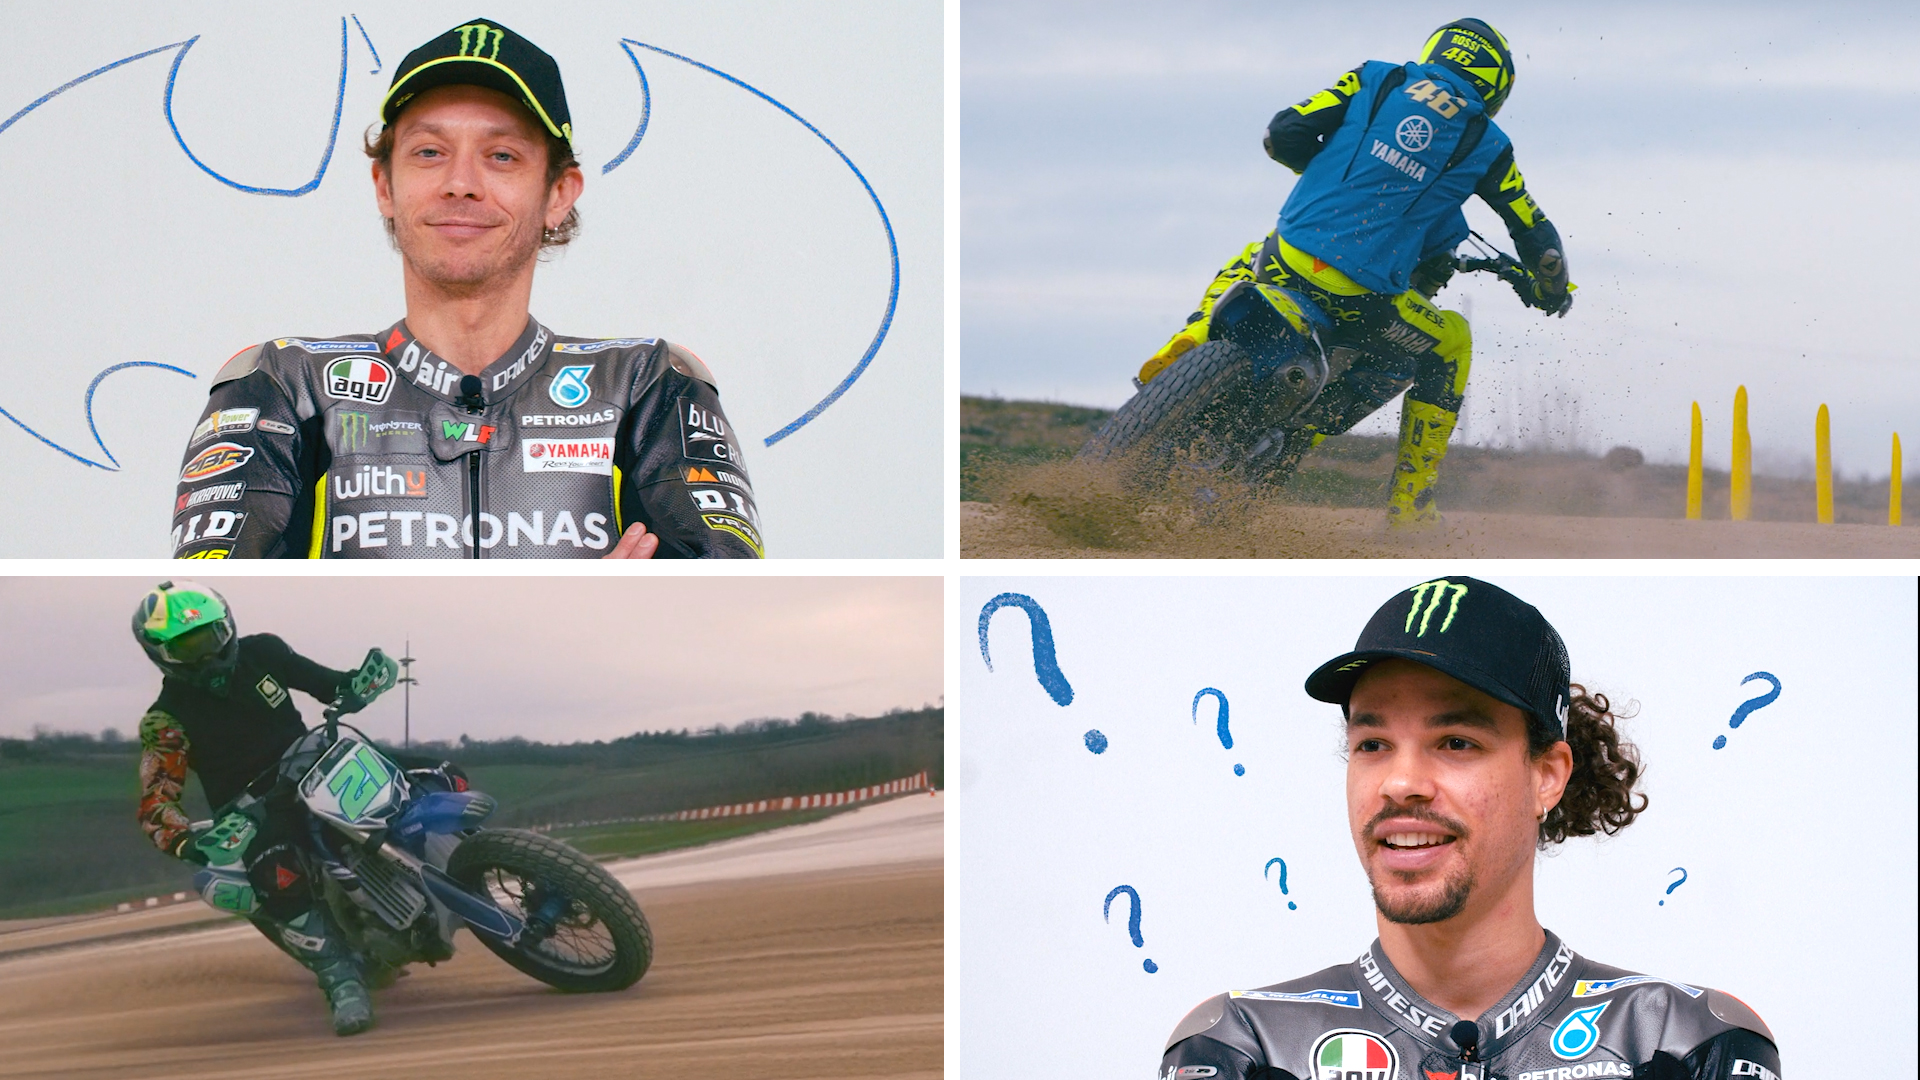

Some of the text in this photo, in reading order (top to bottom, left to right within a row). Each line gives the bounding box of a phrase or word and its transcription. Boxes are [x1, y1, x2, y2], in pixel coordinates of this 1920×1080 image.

[1451, 34, 1480, 53] ROSSI
[1441, 47, 1476, 66] 46
[1403, 79, 1468, 119] 46
[1370, 139, 1427, 182] YAMAHA
[334, 378, 383, 399] agv
[369, 420, 424, 433] MONSTER
[521, 409, 615, 426] PETRONAS
[442, 420, 497, 444] WLF
[547, 443, 610, 460] YAMAHA
[332, 510, 610, 553] PETRONAS
[327, 744, 391, 824] 21
[1268, 993, 1349, 1002] MICHELIN
[1360, 949, 1448, 1038] DAINESE
[1495, 941, 1574, 1040] DAINESE
[1518, 1061, 1633, 1080] PETRONAS
